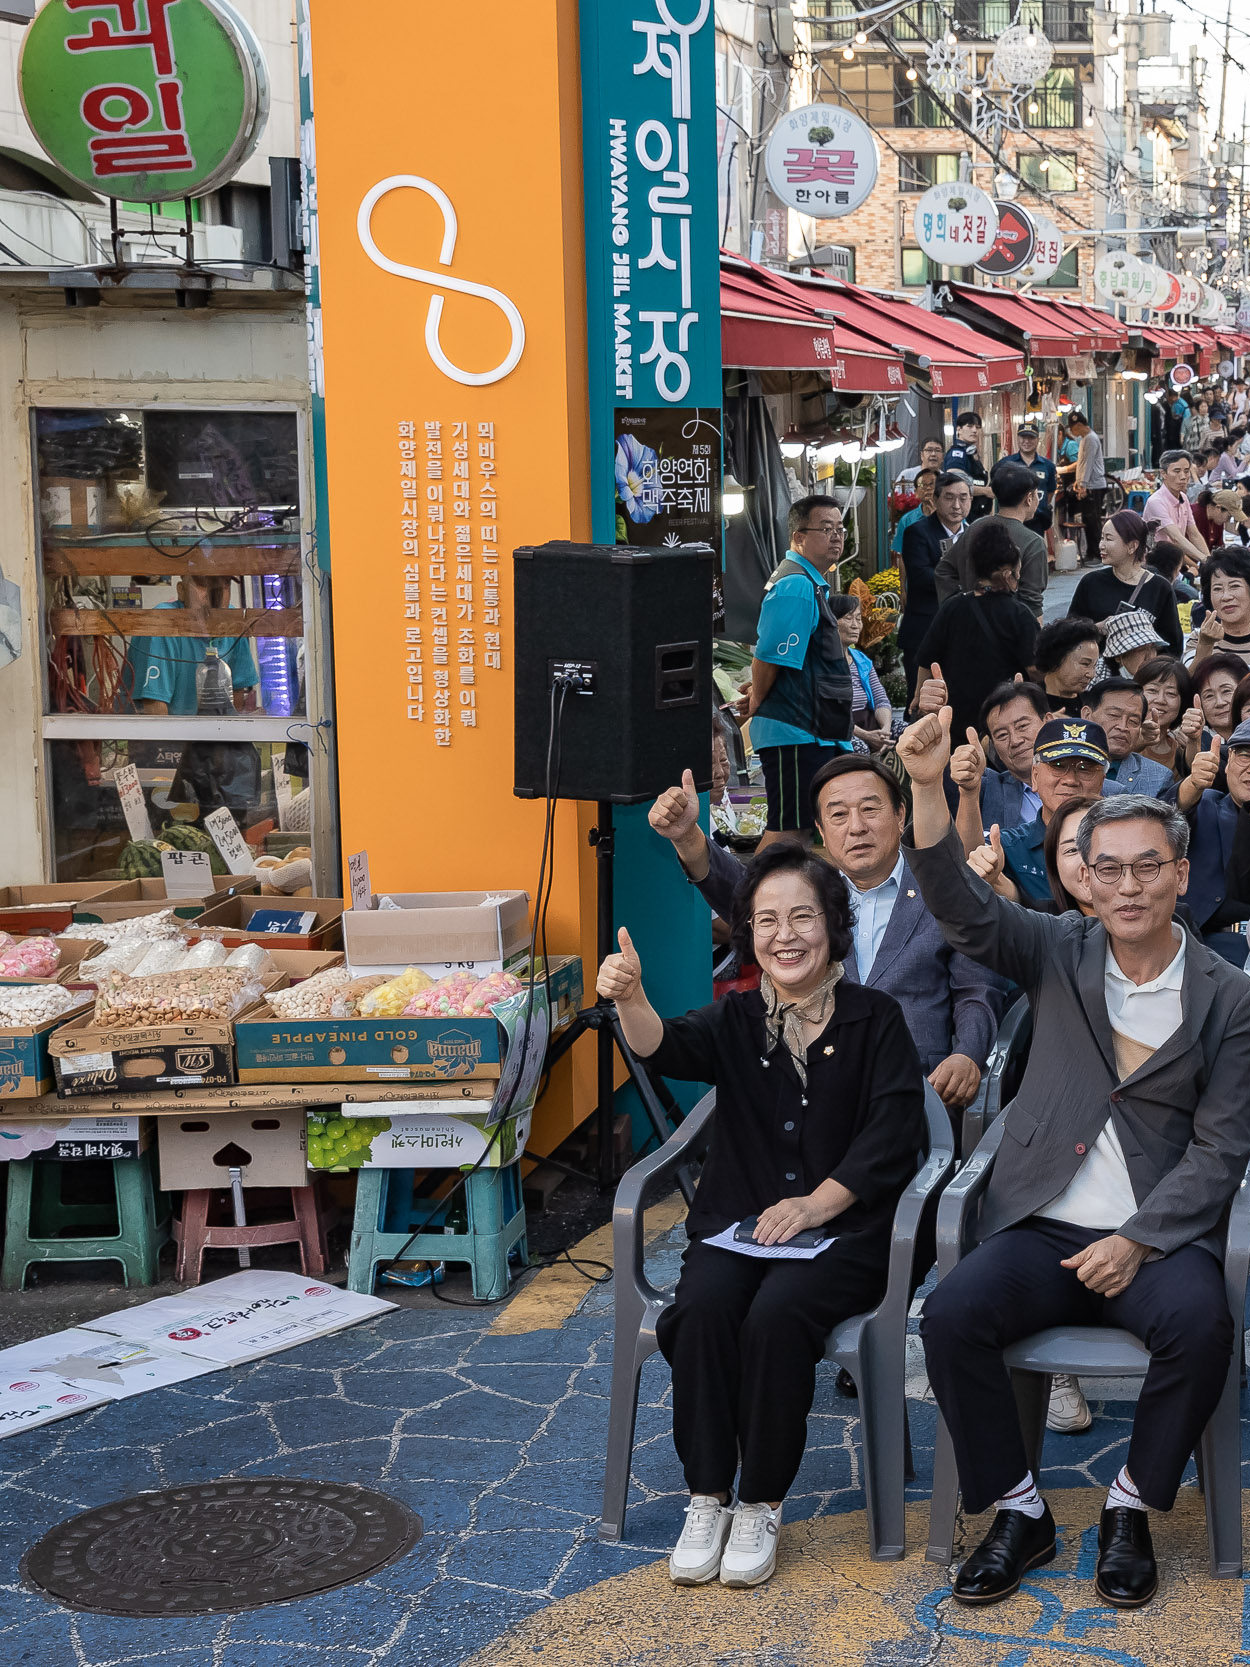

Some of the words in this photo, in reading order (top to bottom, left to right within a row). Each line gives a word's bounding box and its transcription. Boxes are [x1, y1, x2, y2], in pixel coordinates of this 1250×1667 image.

[608, 118, 630, 247] HWAYANG
[783, 148, 858, 185] 꽃
[796, 189, 849, 204] 한아름
[612, 253, 631, 297] JEIL
[613, 303, 632, 400] MARKET
[424, 420, 443, 479] 발전을
[451, 421, 471, 518] 기성세대와
[477, 421, 497, 519] 뫼비우스의
[641, 458, 711, 485] 화양연화
[397, 420, 419, 557] 화양제일시장의
[642, 487, 711, 514] 맥주축제
[481, 525, 499, 563] 띠는
[402, 563, 422, 621] 심볼과
[482, 569, 501, 626] 전통과
[431, 606, 449, 665] 컨셉을
[457, 628, 476, 684] 조화를
[483, 632, 501, 669] 현대
[405, 627, 425, 722] 로고입니다
[432, 669, 452, 746] 형상화한
[460, 689, 477, 727] 이뤄
[271, 1030, 367, 1044] PINEAPPLE
[375, 1030, 418, 1041] GOLD
[427, 1040, 481, 1058] manna
[391, 1133, 464, 1148] 샤인머스켓
